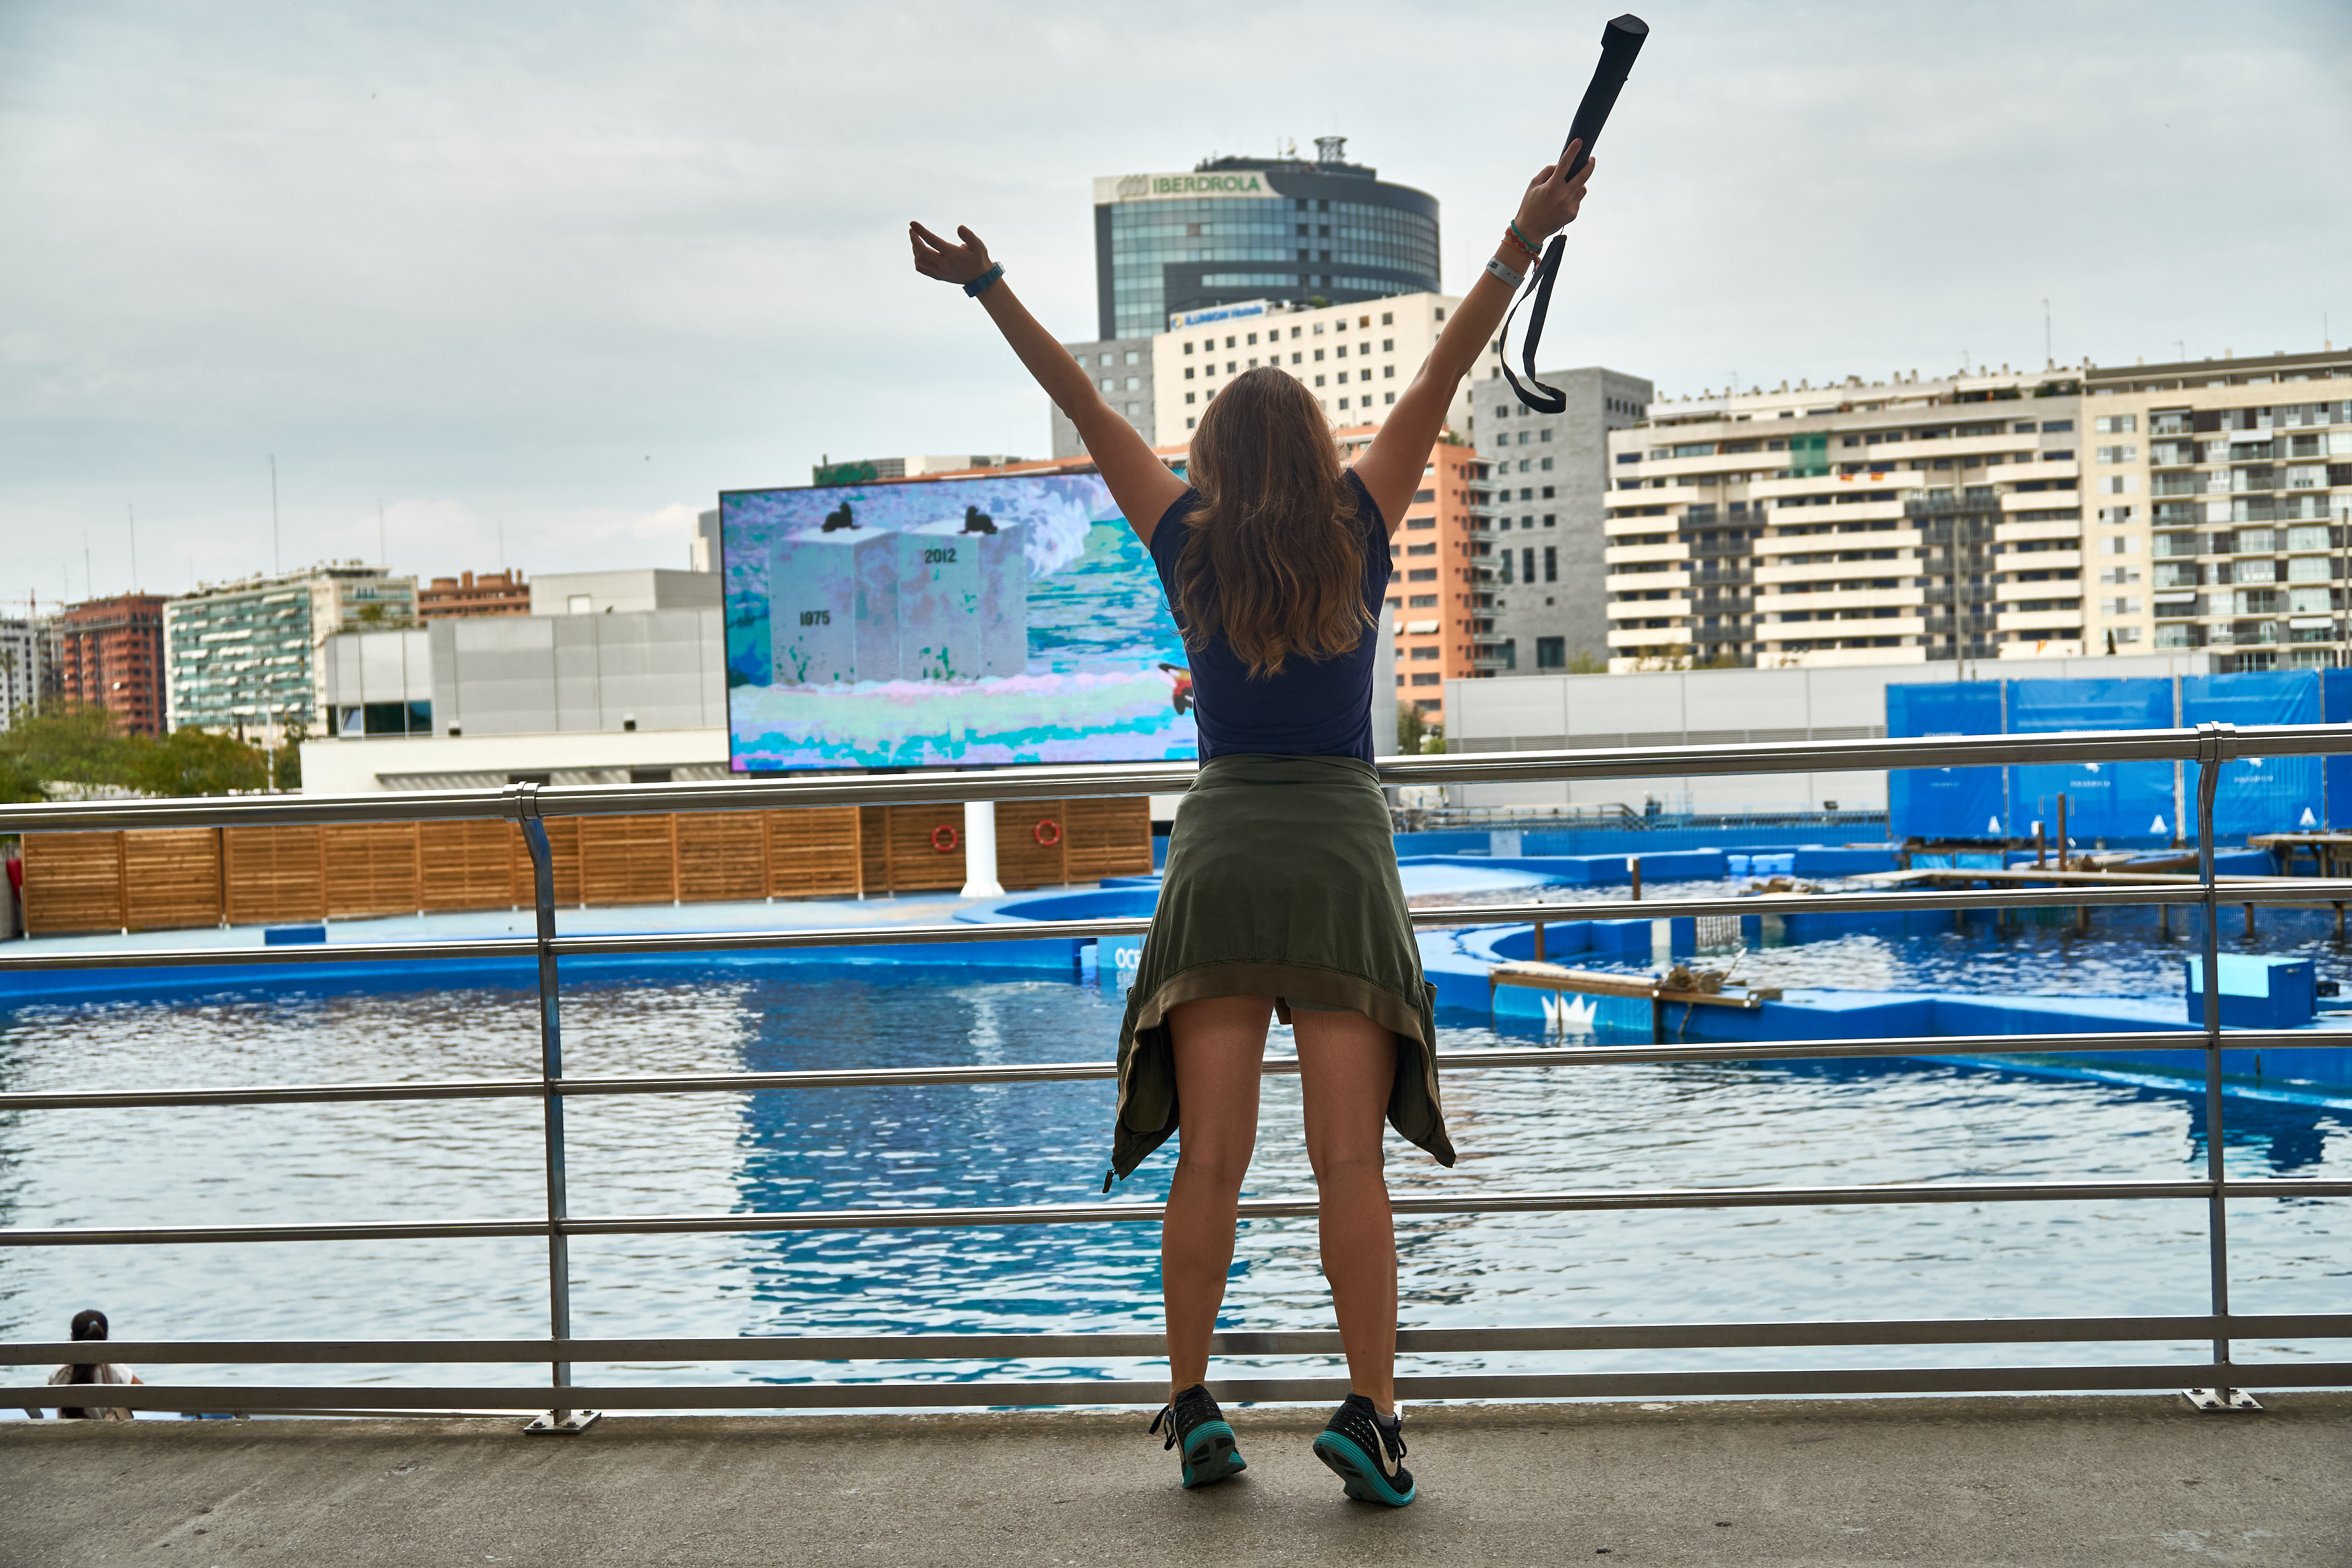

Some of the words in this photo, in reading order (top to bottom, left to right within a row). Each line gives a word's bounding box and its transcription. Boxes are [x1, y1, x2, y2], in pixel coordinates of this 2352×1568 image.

[1152, 175, 1261, 194] IBERDROLA
[924, 548, 957, 564] 2012
[800, 610, 830, 626] 1975
